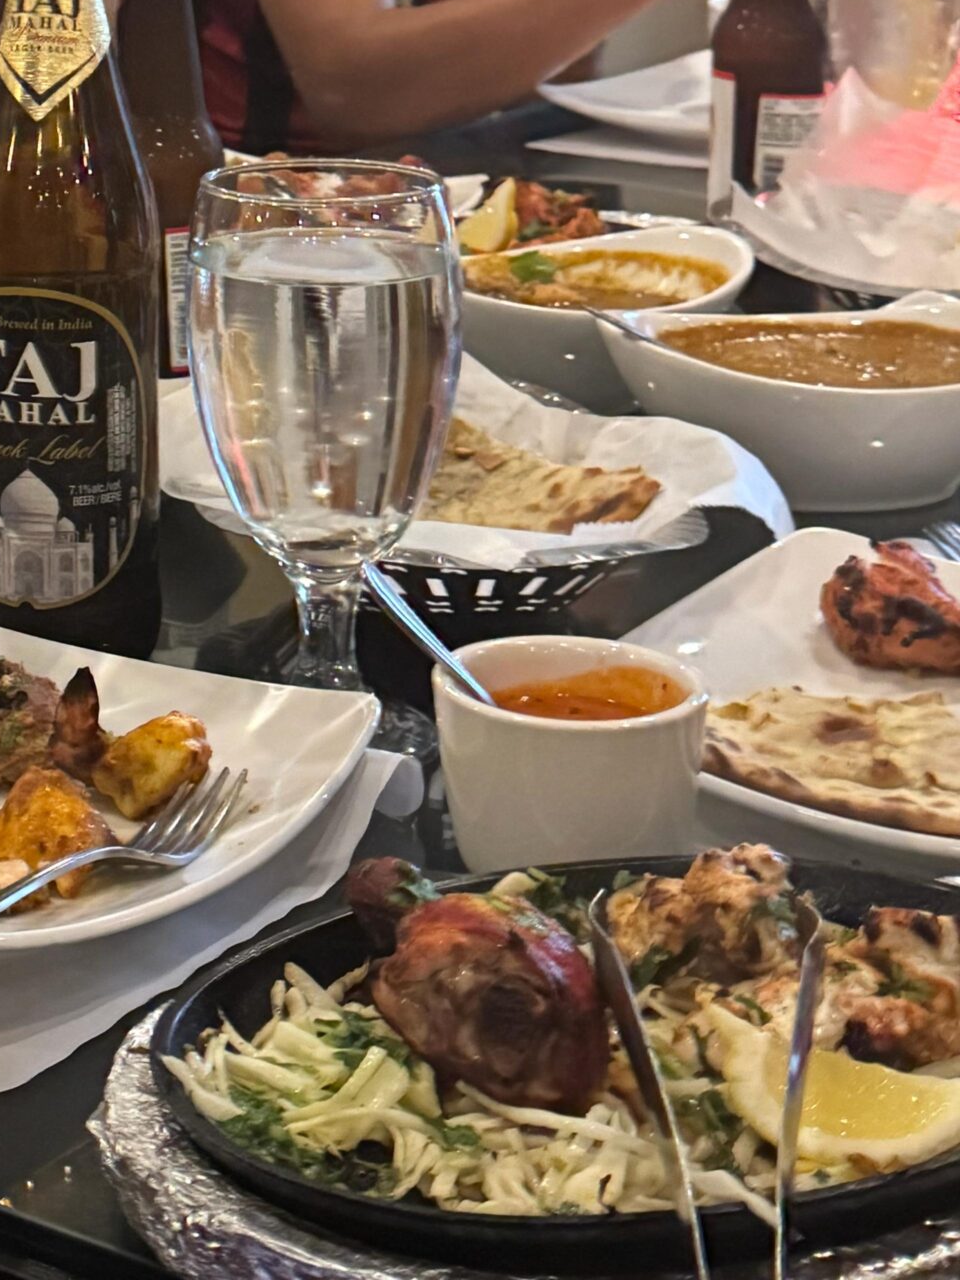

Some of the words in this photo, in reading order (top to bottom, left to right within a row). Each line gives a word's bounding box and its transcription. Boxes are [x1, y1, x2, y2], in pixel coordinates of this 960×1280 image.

[9, 16, 82, 32] MAHAL
[41, 318, 55, 330] in
[58, 317, 93, 331] India
[27, 434, 107, 466] Label
